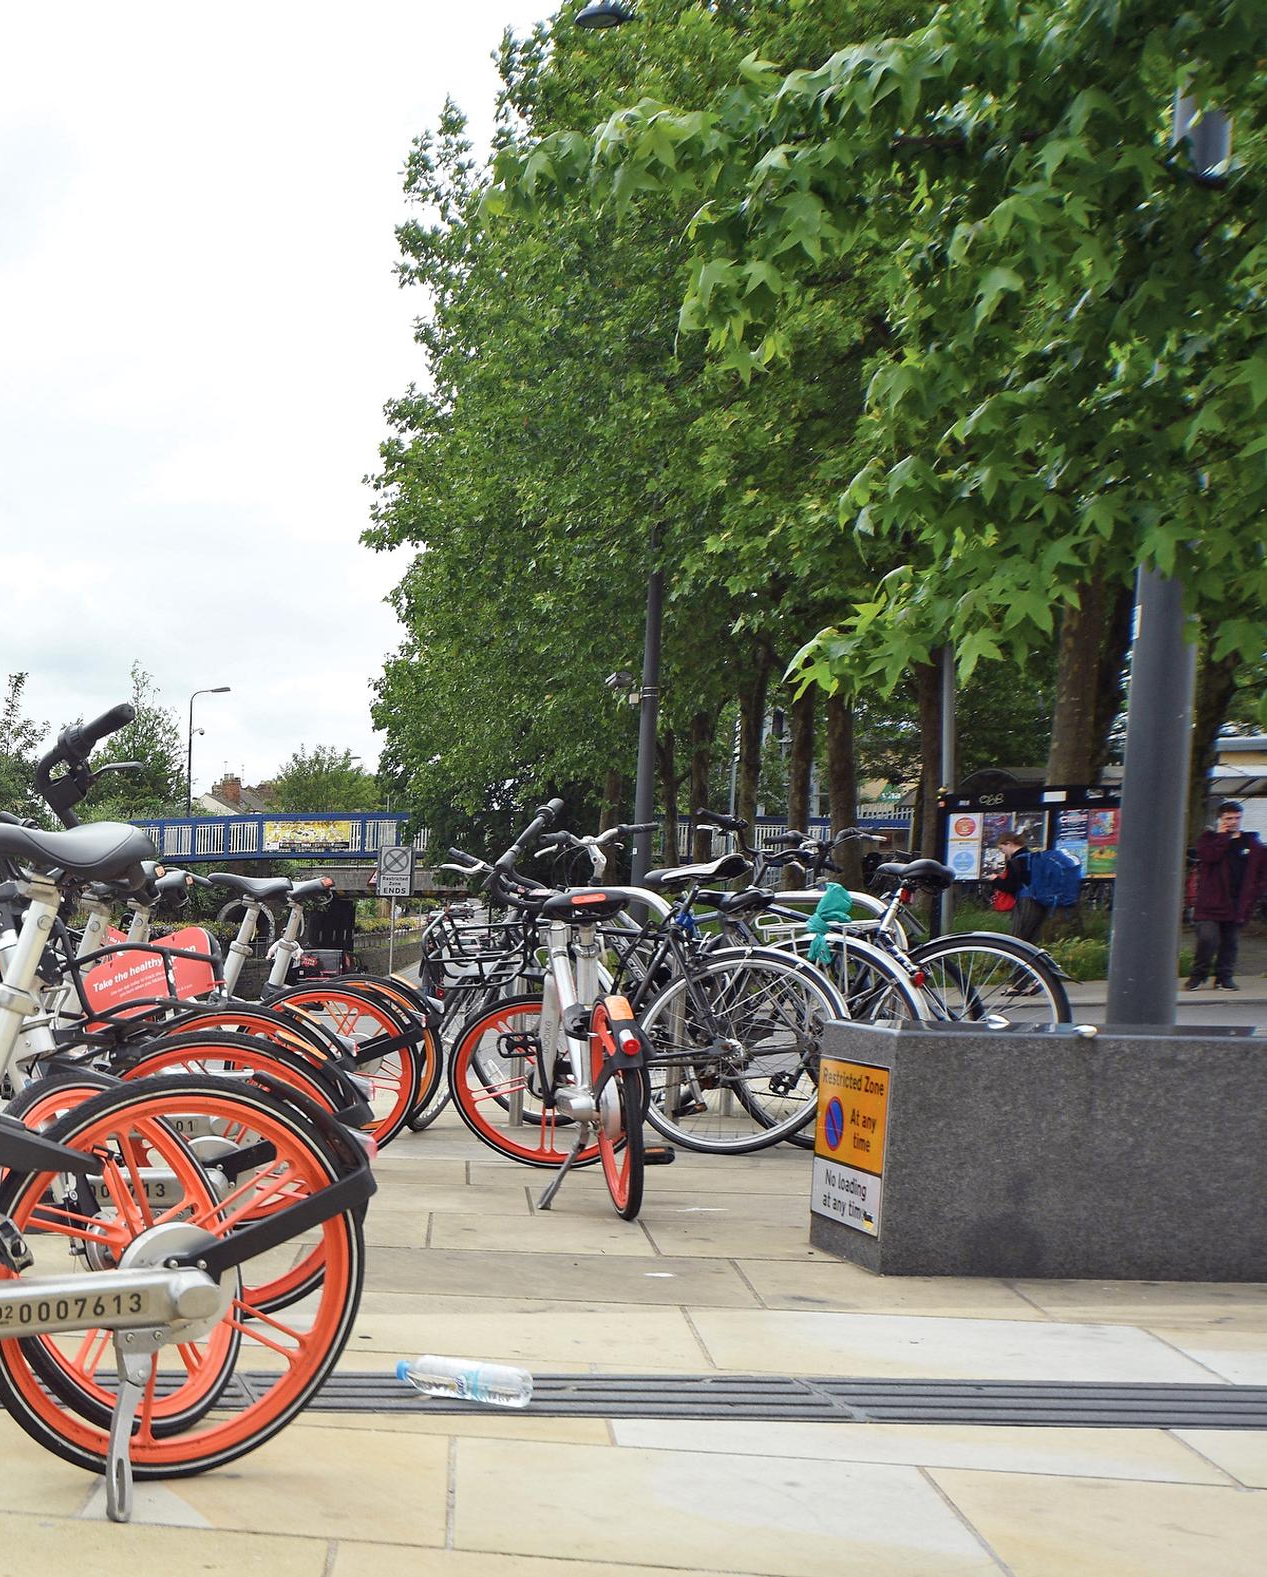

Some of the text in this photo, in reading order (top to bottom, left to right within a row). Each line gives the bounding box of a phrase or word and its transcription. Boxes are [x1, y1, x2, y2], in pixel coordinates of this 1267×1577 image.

[93, 979, 114, 993] Take
[114, 970, 129, 984] the
[129, 957, 164, 977] healthy
[822, 1067, 885, 1096] Restricted Zone
[850, 1108, 877, 1134] At any
[853, 1132, 871, 1153] time
[825, 1168, 867, 1201] No loading
[823, 1192, 831, 1208] at
[832, 1200, 846, 1217] any
[19, 1293, 142, 1324] 0007613
